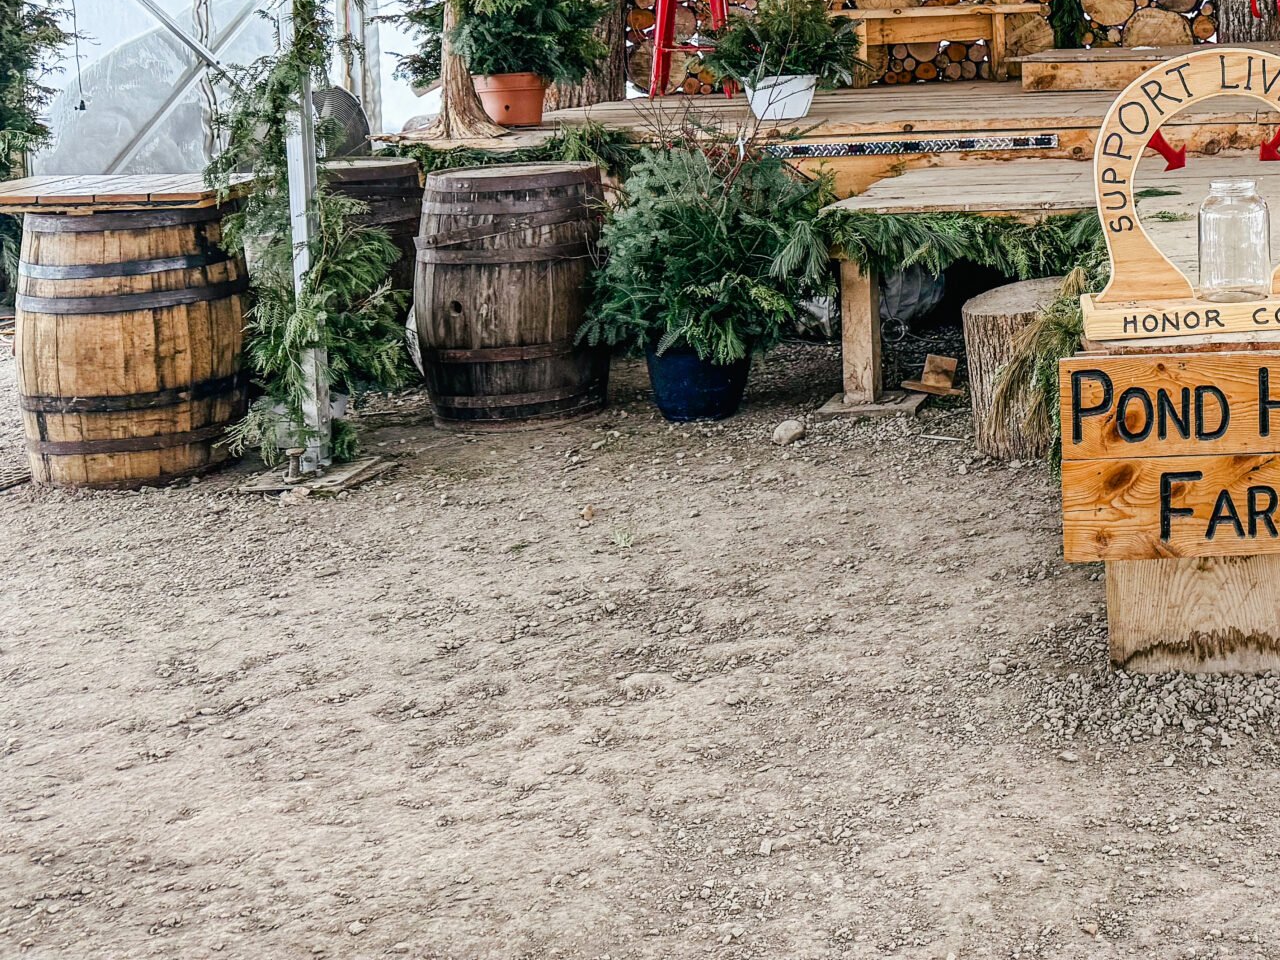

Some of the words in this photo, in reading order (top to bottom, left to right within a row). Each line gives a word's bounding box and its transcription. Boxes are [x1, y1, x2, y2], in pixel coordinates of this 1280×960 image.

[1102, 62, 1193, 233] SUPPORT
[1123, 309, 1225, 334] HONOR
[1070, 369, 1231, 445] POND
